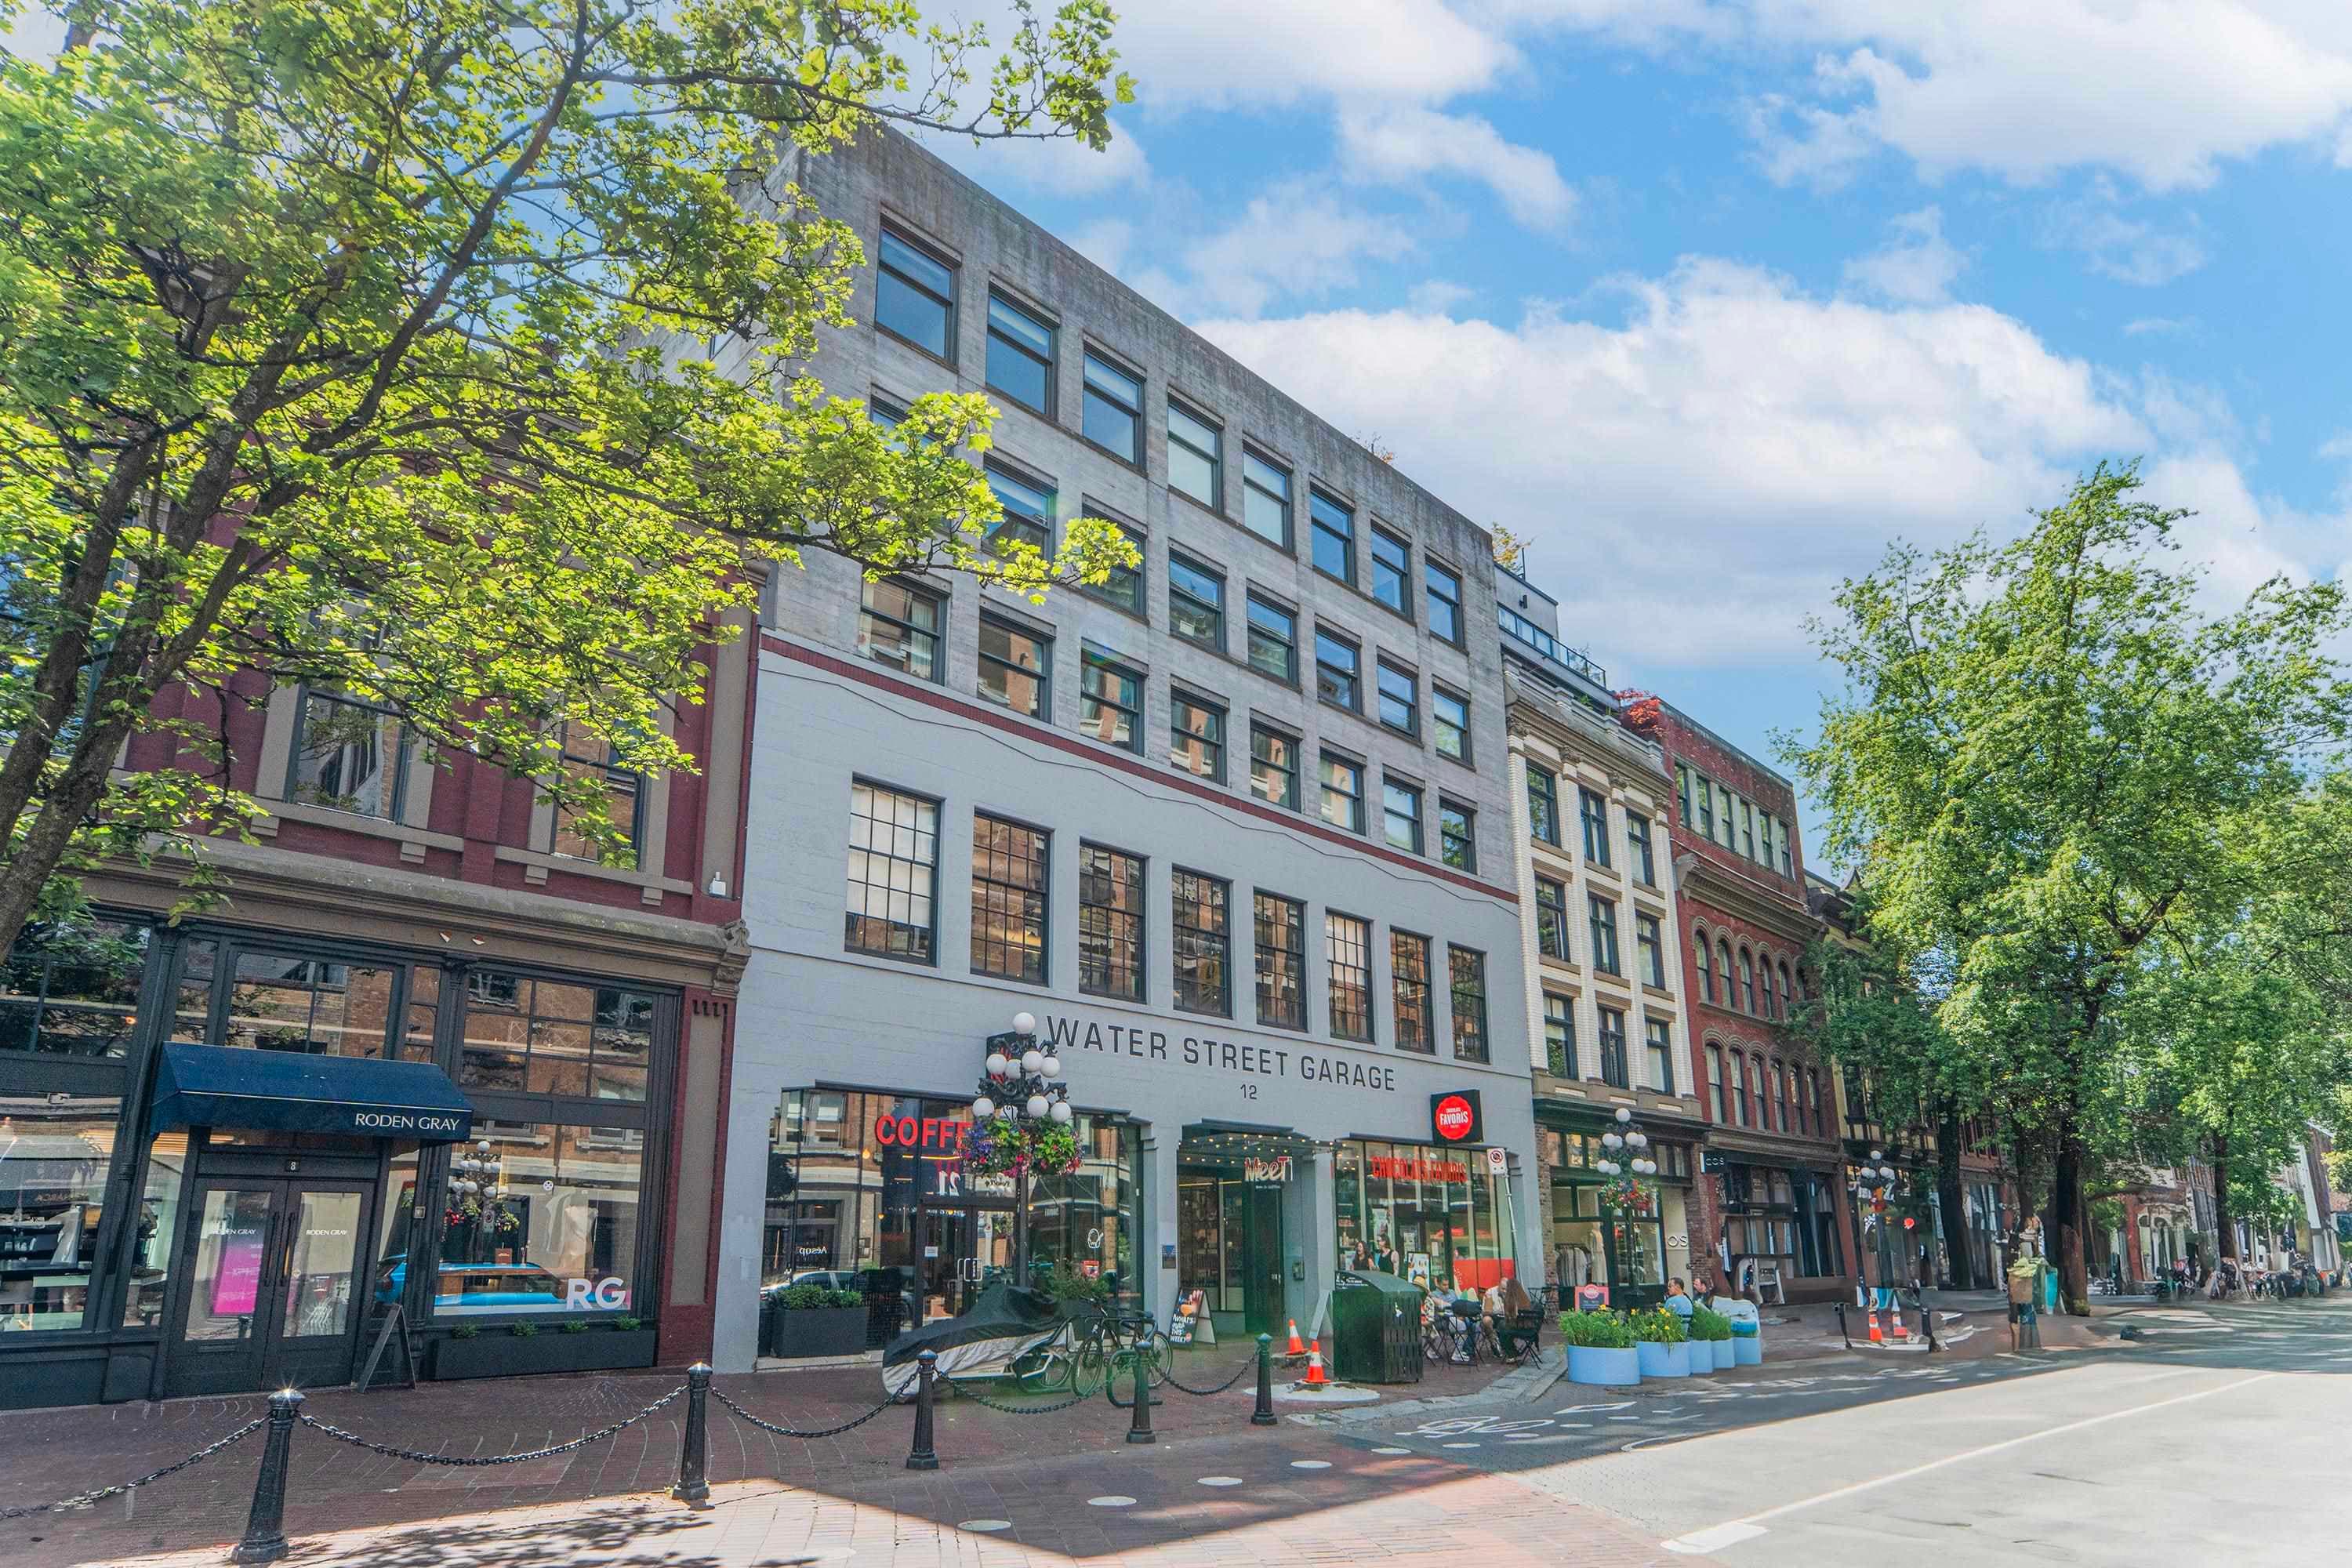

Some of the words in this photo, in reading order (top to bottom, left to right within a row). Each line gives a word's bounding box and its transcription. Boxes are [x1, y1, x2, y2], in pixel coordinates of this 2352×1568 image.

[1047, 1015, 1167, 1060] WATER
[1184, 1037, 1288, 1076] STREET
[1301, 1055, 1395, 1091] GARAGE
[1240, 1084, 1257, 1099] 12
[355, 1113, 414, 1128] RODEN
[419, 1116, 460, 1131] GRAY
[1439, 1111, 1468, 1125] FAVORIS
[875, 1115, 975, 1149] COFFE
[290, 1161, 296, 1171] 8
[1705, 1157, 1724, 1167] COS
[566, 1276, 626, 1310] RG
